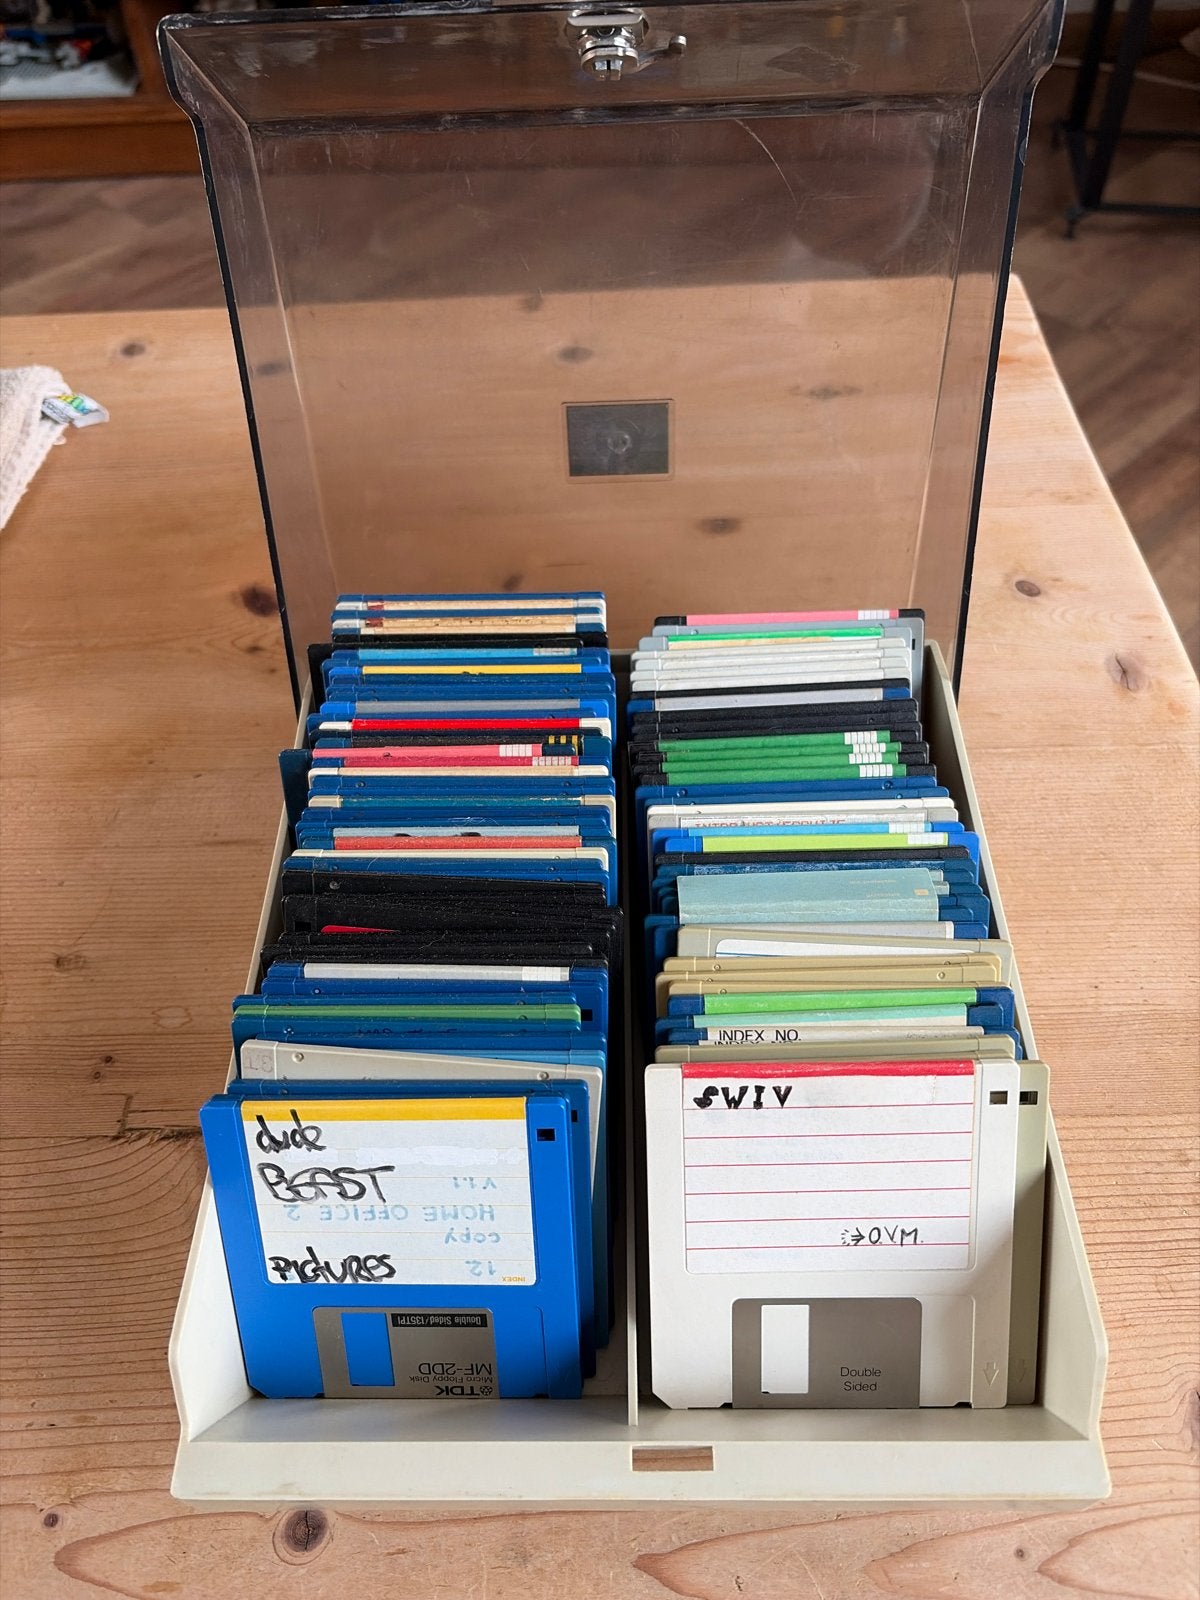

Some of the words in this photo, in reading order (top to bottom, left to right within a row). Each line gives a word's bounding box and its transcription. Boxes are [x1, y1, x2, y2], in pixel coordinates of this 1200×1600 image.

[719, 1029, 765, 1041] INDEX
[775, 1029, 801, 1041] NO.
[693, 1085, 792, 1110] SWIV
[319, 1204, 408, 1221] OFFICE
[422, 1203, 495, 1222] HOME
[465, 1260, 496, 1277] 12
[454, 1315, 481, 1325] Double
[418, 1362, 493, 1376] MF-2DD
[840, 1366, 882, 1377] Double
[408, 1375, 430, 1384] Disk
[432, 1375, 464, 1384] Floppy
[466, 1376, 493, 1384] Micro
[434, 1385, 481, 1396] TDK
[843, 1381, 878, 1392] Sided
